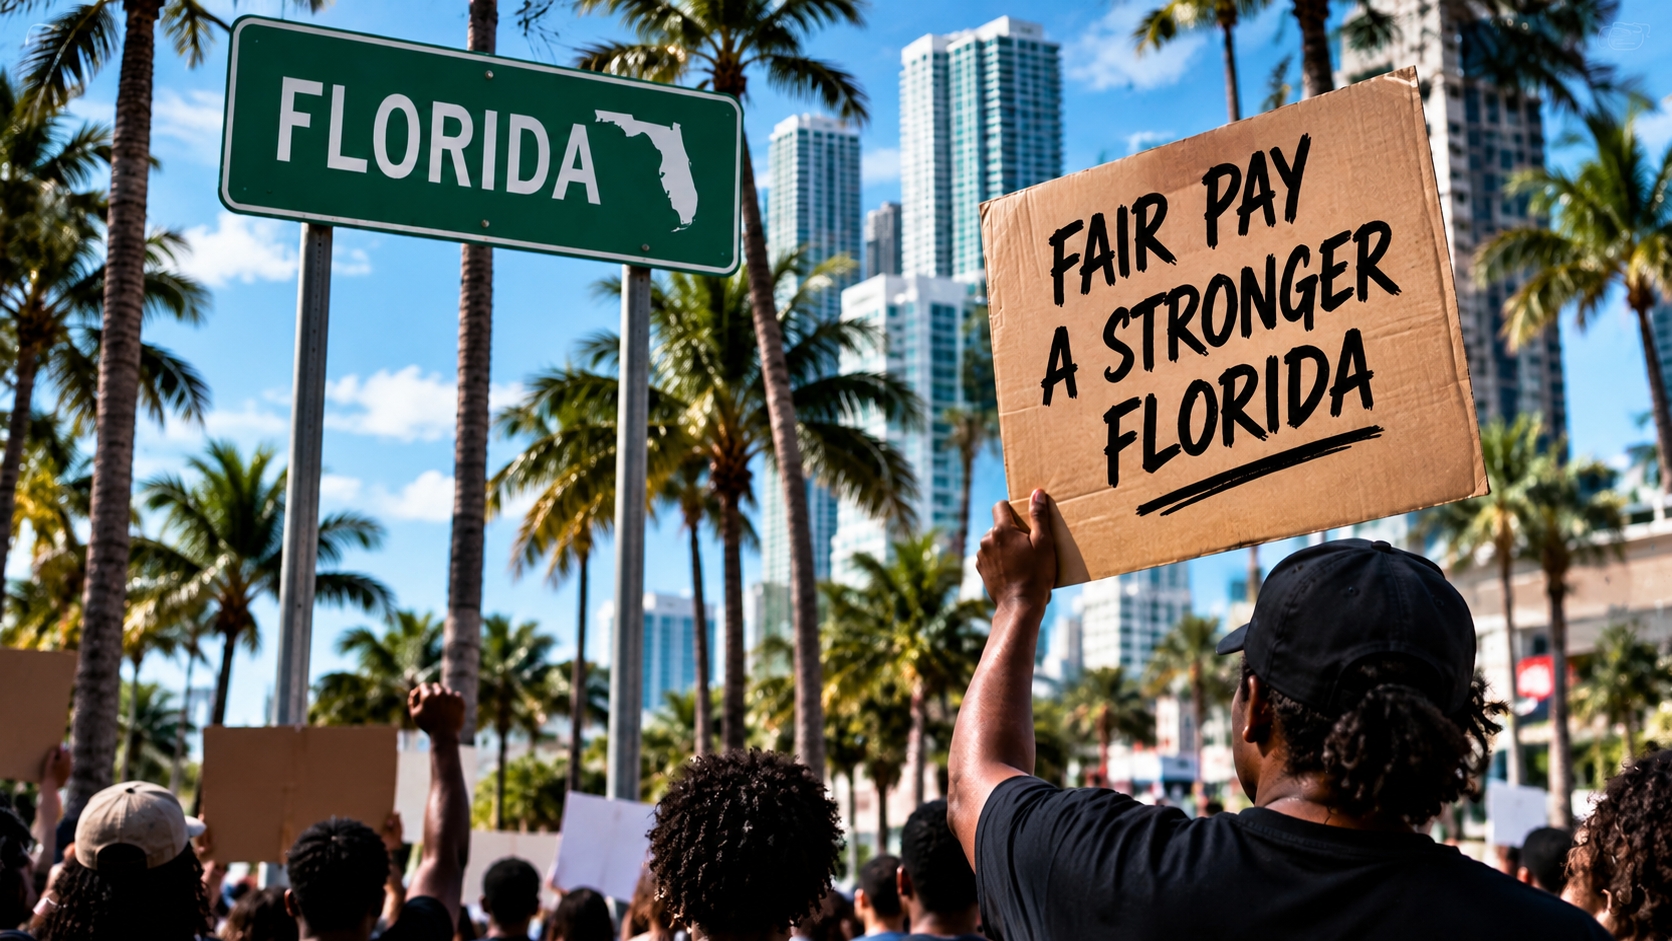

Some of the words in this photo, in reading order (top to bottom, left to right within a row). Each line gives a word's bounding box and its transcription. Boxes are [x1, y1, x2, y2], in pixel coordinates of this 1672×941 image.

[276, 76, 601, 205] FLORIDA
[1048, 192, 1178, 308] FAIR
[1201, 132, 1312, 250] PAY
[1040, 325, 1079, 407] A
[1102, 220, 1403, 384] STRONGER
[1102, 327, 1375, 489] FLORIDA
